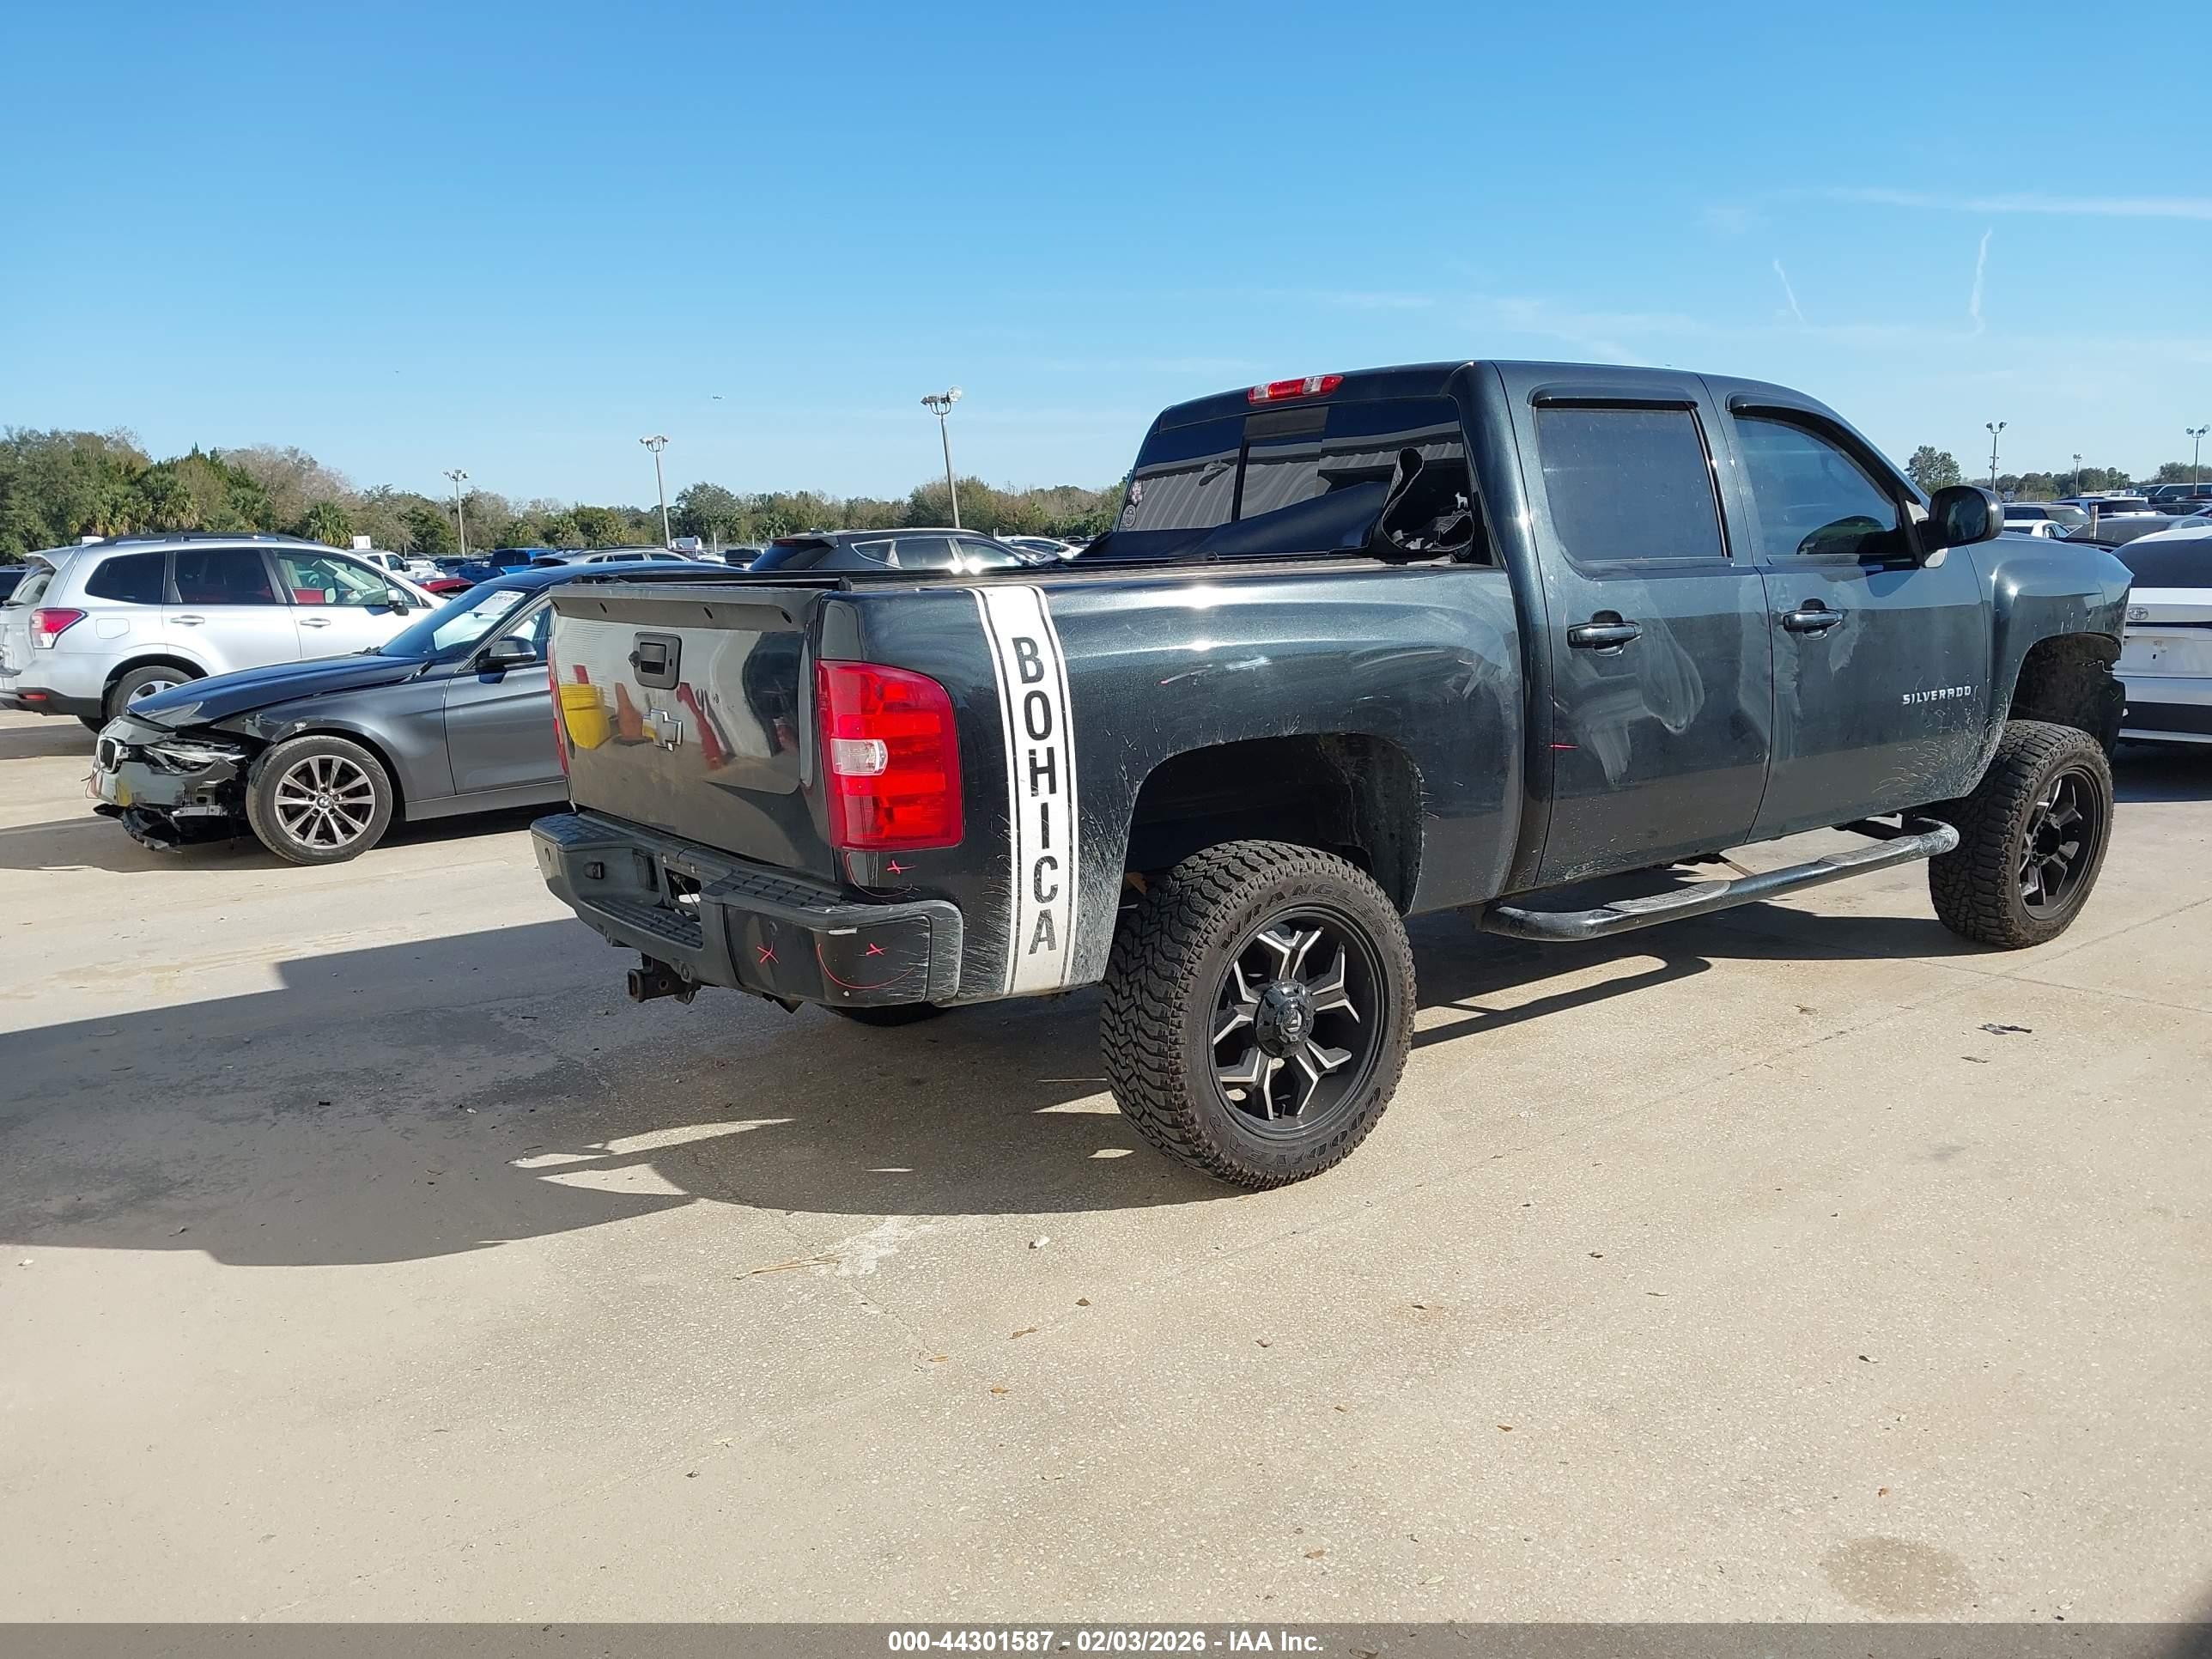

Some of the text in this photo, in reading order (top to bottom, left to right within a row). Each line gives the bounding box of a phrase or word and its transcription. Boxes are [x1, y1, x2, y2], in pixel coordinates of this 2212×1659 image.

[1901, 685, 1972, 705] SILVERADO
[1012, 636, 1059, 956] BOHICA
[1218, 883, 1389, 951] WRANGLER
[1208, 1086, 1382, 1169] GOODYEAR
